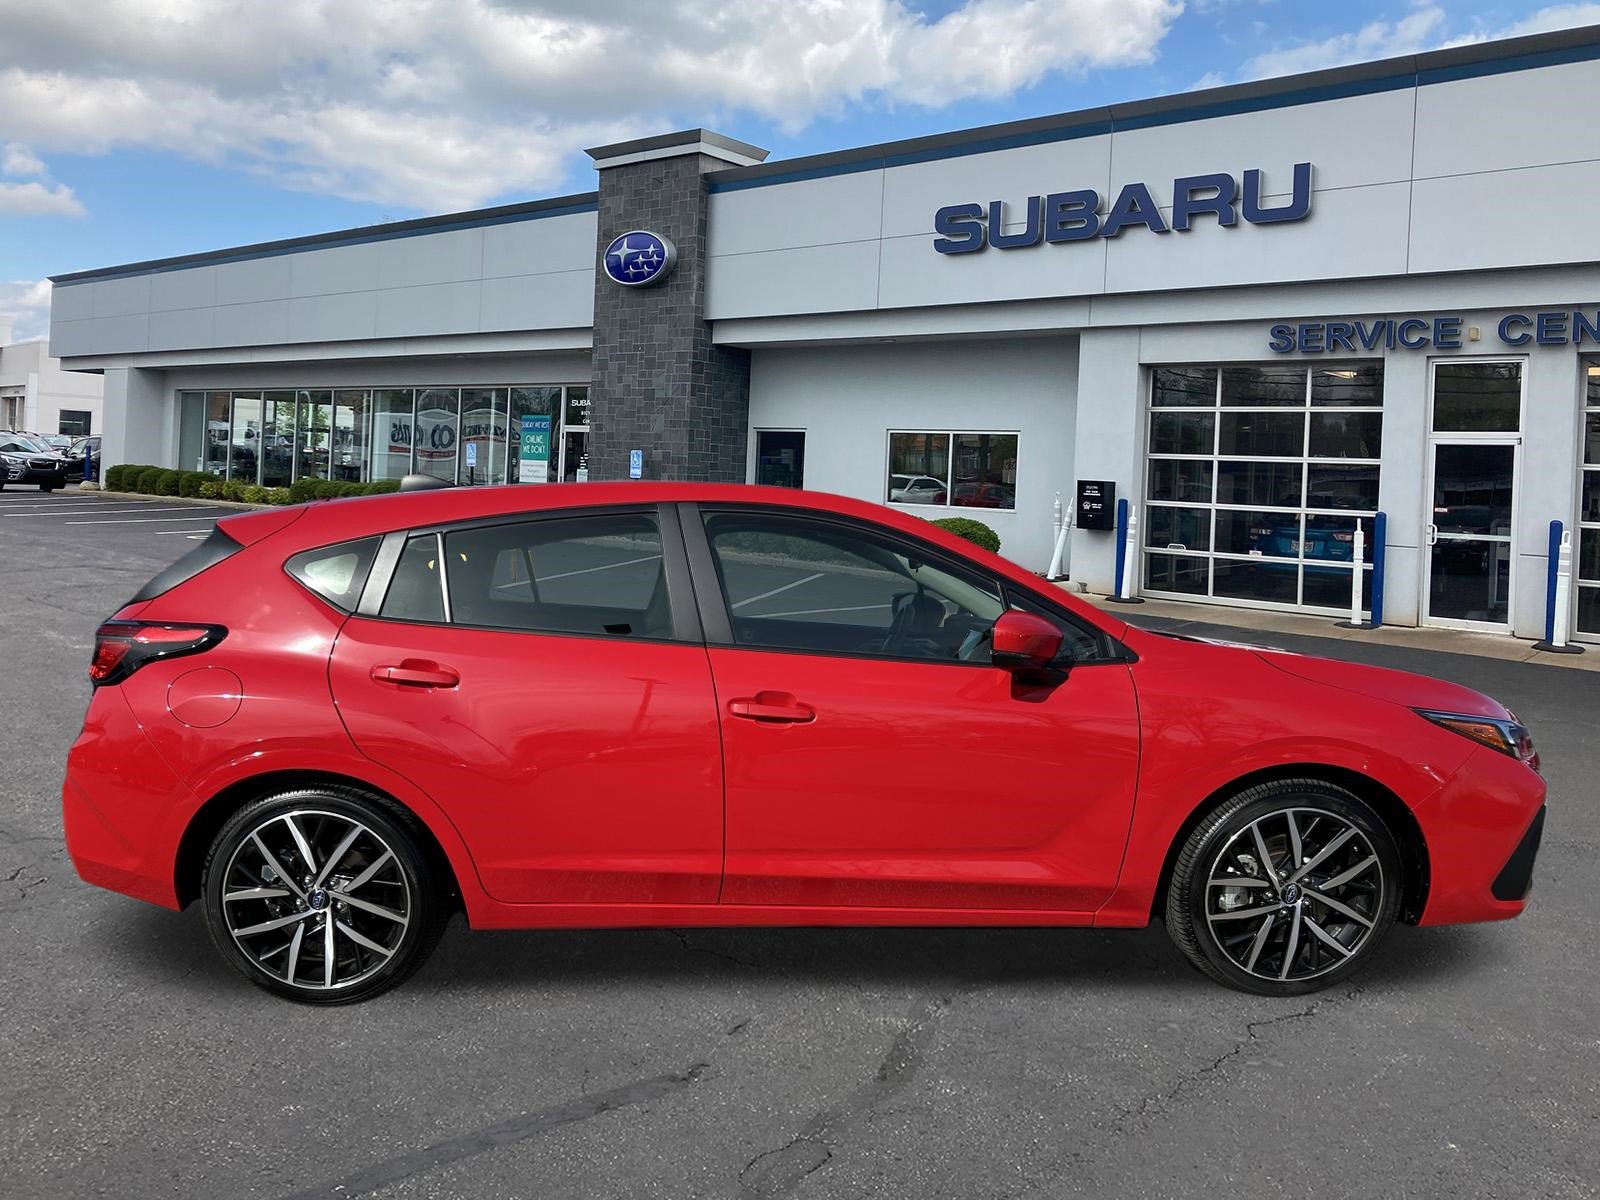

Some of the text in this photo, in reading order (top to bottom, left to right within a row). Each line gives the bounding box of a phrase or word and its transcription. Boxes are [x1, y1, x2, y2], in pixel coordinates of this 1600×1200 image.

[933, 162, 1313, 255] SUBARU
[1269, 311, 1600, 353] SERVICE CEN
